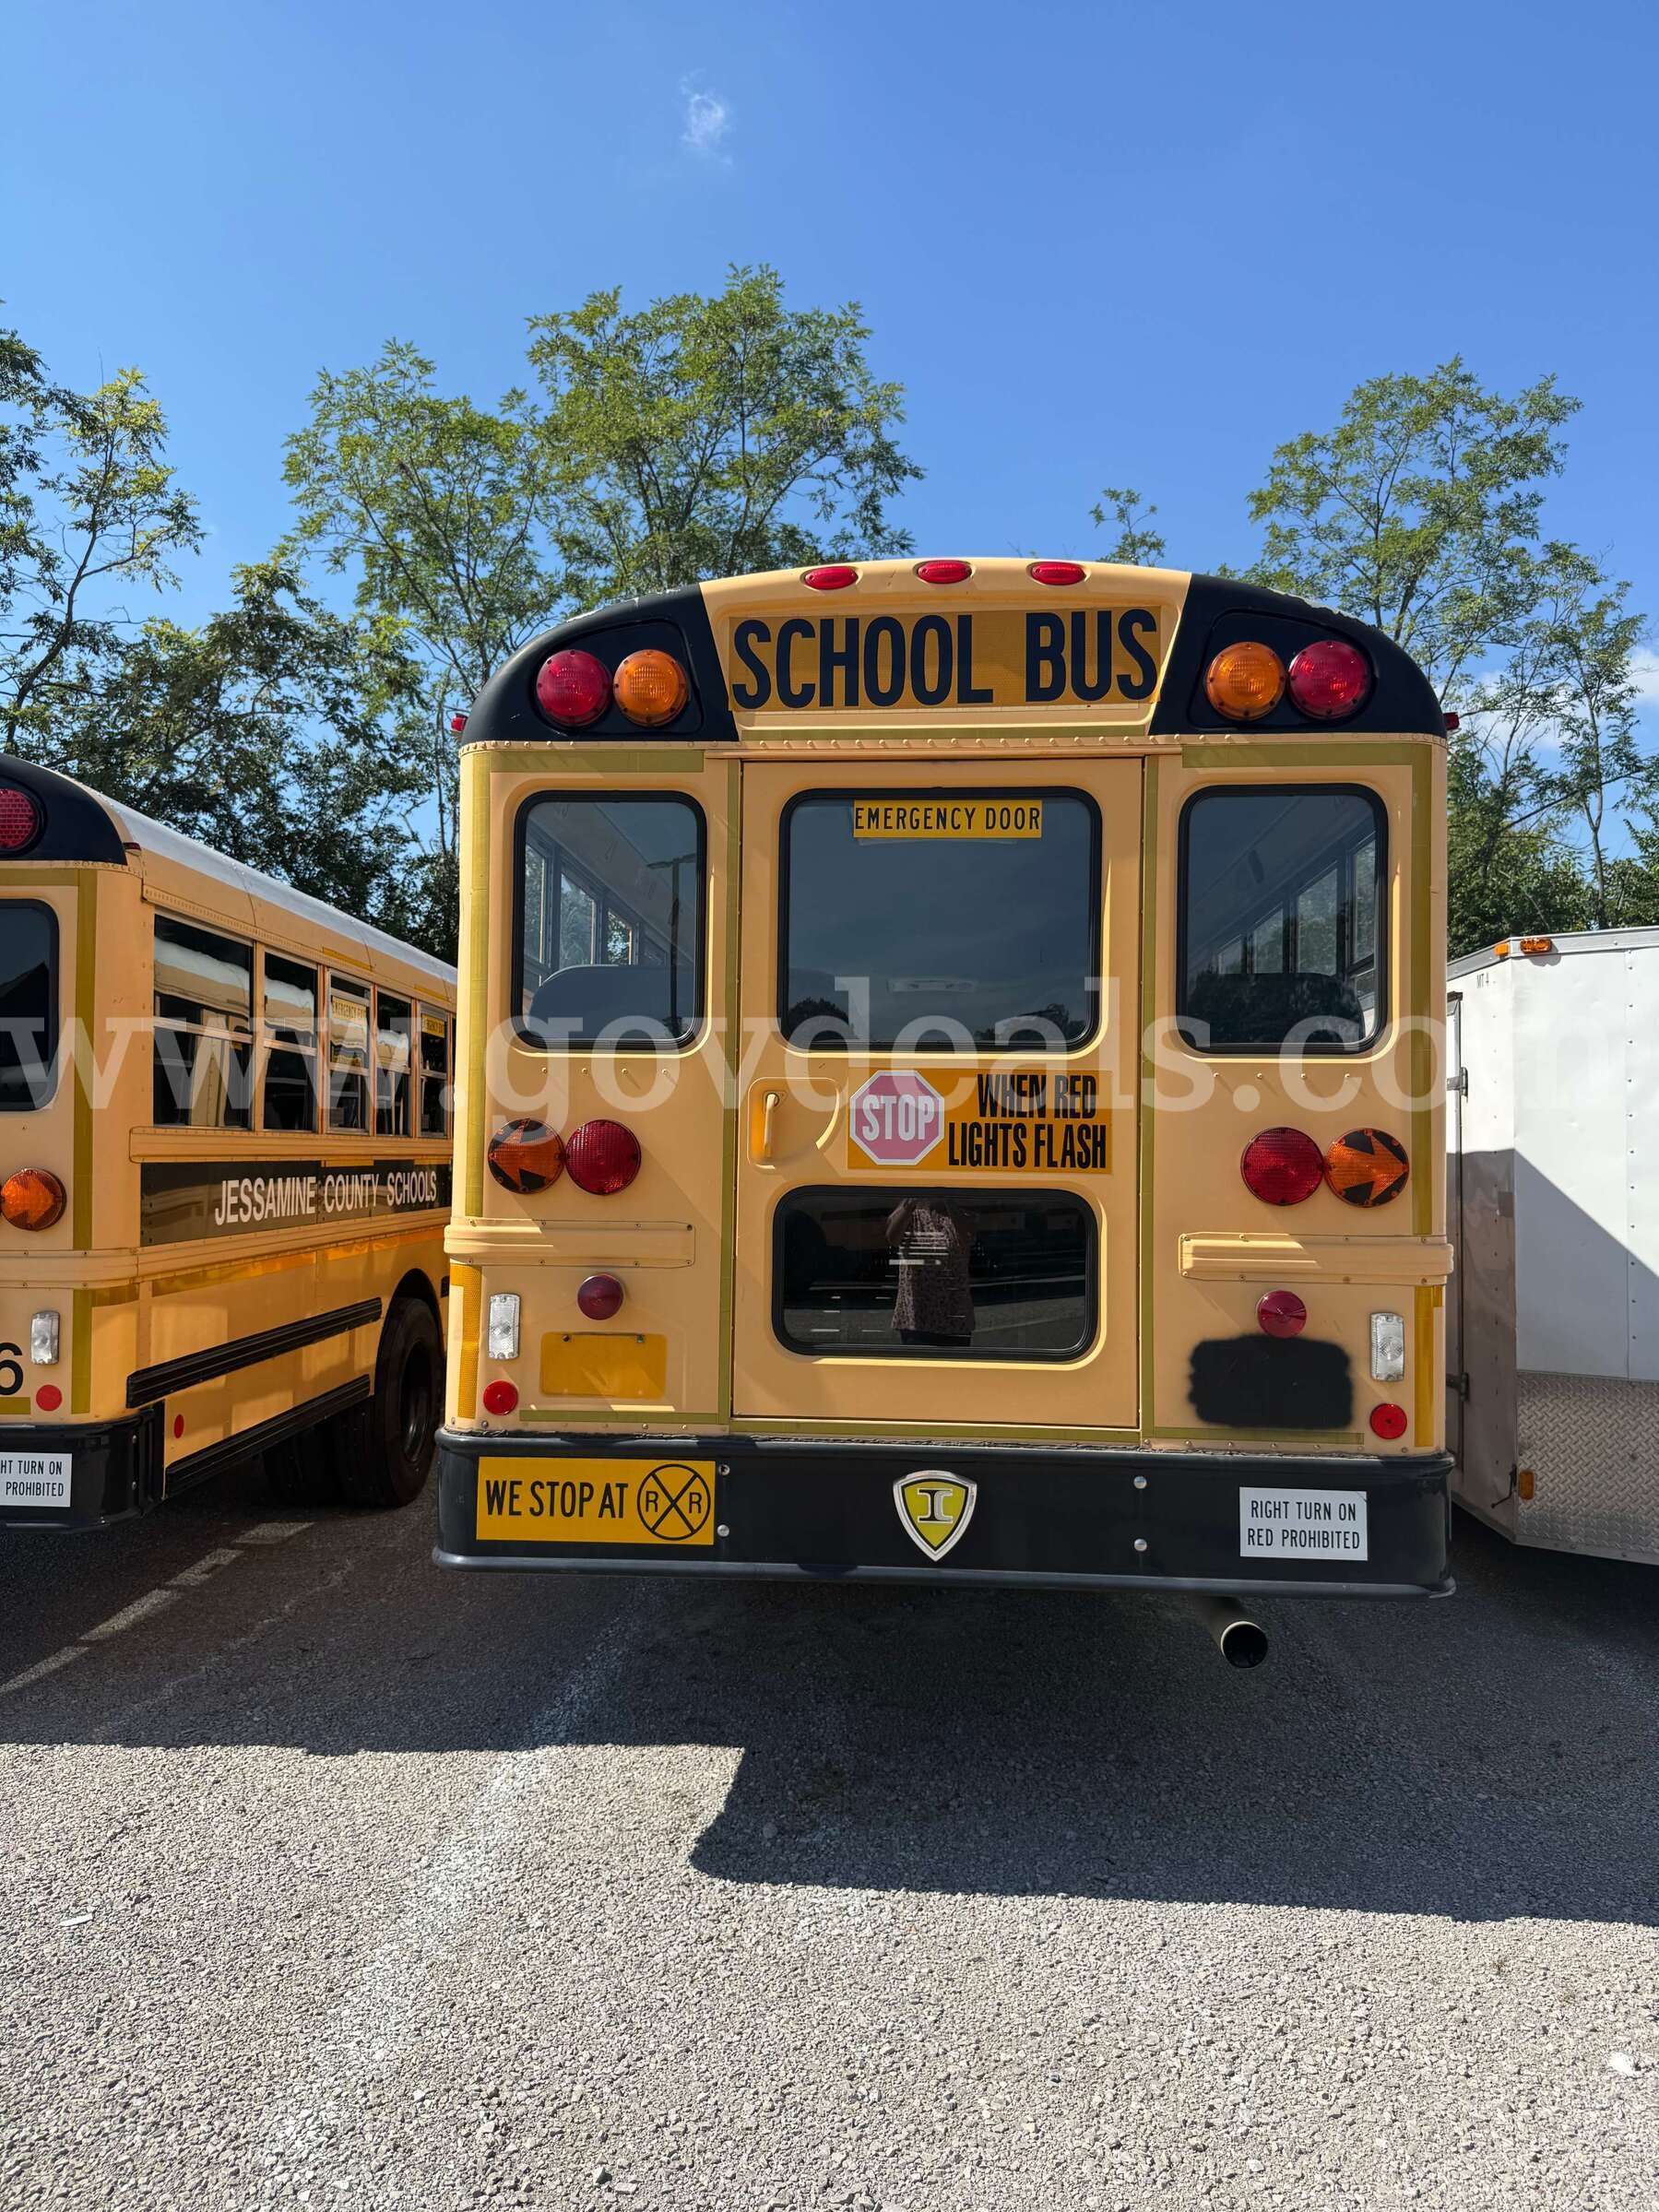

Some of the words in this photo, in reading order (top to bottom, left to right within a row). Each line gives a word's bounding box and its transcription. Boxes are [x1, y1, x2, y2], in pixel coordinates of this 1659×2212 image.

[732, 614, 993, 709] SCHOOL
[1025, 609, 1158, 703] BUS
[855, 808, 976, 830] EMERGENCY
[986, 808, 1040, 830] DOOR
[977, 1074, 1047, 1118] WHEN
[1054, 1075, 1096, 1118] RED
[862, 1094, 935, 1141] STOP
[948, 1122, 1026, 1166] LIGHTS
[1034, 1124, 1107, 1168] FLASH
[215, 1177, 316, 1225] JESSAMINE
[325, 1174, 379, 1213] COUNTY
[387, 1171, 437, 1206] SCHOOLS
[18, 1461, 44, 1474] TURN
[49, 1461, 63, 1475] ON
[6, 1482, 65, 1496] PROHIBITED
[486, 1480, 523, 1516] WE
[529, 1481, 594, 1518] STOP
[598, 1483, 629, 1519] AT
[1250, 1500, 1289, 1519] RIGHT
[1297, 1502, 1332, 1520] TURN
[1339, 1503, 1356, 1521] ON
[1248, 1528, 1274, 1546] RED
[1282, 1529, 1360, 1549] PROHIBITED
